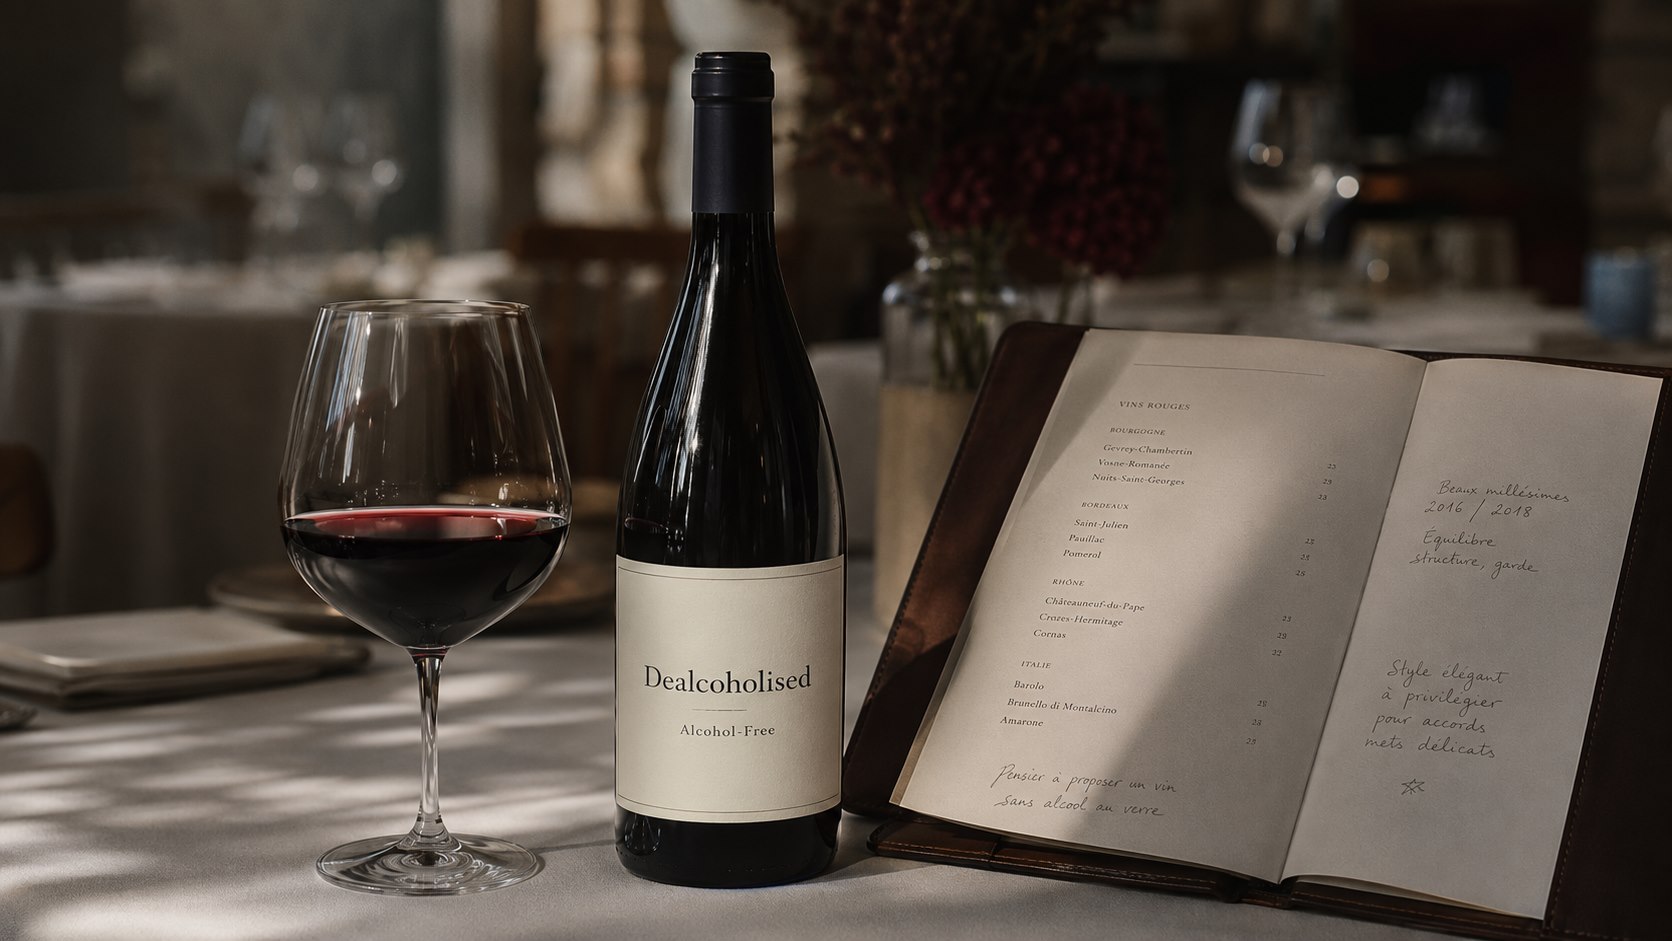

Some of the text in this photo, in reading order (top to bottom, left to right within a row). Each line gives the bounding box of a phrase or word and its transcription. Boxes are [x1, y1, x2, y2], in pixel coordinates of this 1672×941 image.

[1119, 400, 1190, 411] VINS ROUGES
[1109, 427, 1166, 436] BOURGOGNE
[1103, 444, 1193, 456] Gevrey-Chambertin
[1098, 458, 1171, 470] Vosne-Romanée
[1091, 473, 1185, 487] Nuits-Saint-Georges
[1436, 479, 1569, 502] Beaux millésimes
[1081, 501, 1129, 510] BORDEAUX
[1423, 500, 1464, 513] 2016
[1490, 503, 1533, 518] 2018
[1073, 518, 1129, 530] Saint-Julien
[1068, 534, 1106, 544] Pauillac
[1423, 526, 1496, 551] Équilibre
[1062, 549, 1102, 559] Pomerol
[1409, 551, 1538, 579] structure, garde
[1052, 578, 1086, 587] RHÔNE
[1045, 596, 1145, 613] Châteauneuf-du-Pape
[1039, 613, 1124, 628] Crozes-Hermitage
[1033, 629, 1067, 639] Cornas
[1021, 660, 1052, 669] ITALIE
[645, 665, 810, 693] Dealcoholised
[1387, 659, 1509, 692] Style élégant
[1013, 680, 1045, 691] Barolo
[1007, 697, 1118, 714] Brunello di Montalcino
[1381, 686, 1503, 717] à privilégier
[999, 716, 1044, 727] Amarone
[1372, 715, 1486, 734] pour accords
[680, 724, 776, 737] Alcohol-Free
[1364, 734, 1495, 758] mets délicats
[1051, 771, 1062, 783] à
[1064, 776, 1123, 794] proposer
[1128, 781, 1146, 790] un
[1154, 779, 1177, 793] vin
[1043, 794, 1089, 811] alcool
[1095, 803, 1114, 813] au
[1123, 805, 1165, 817] verre
